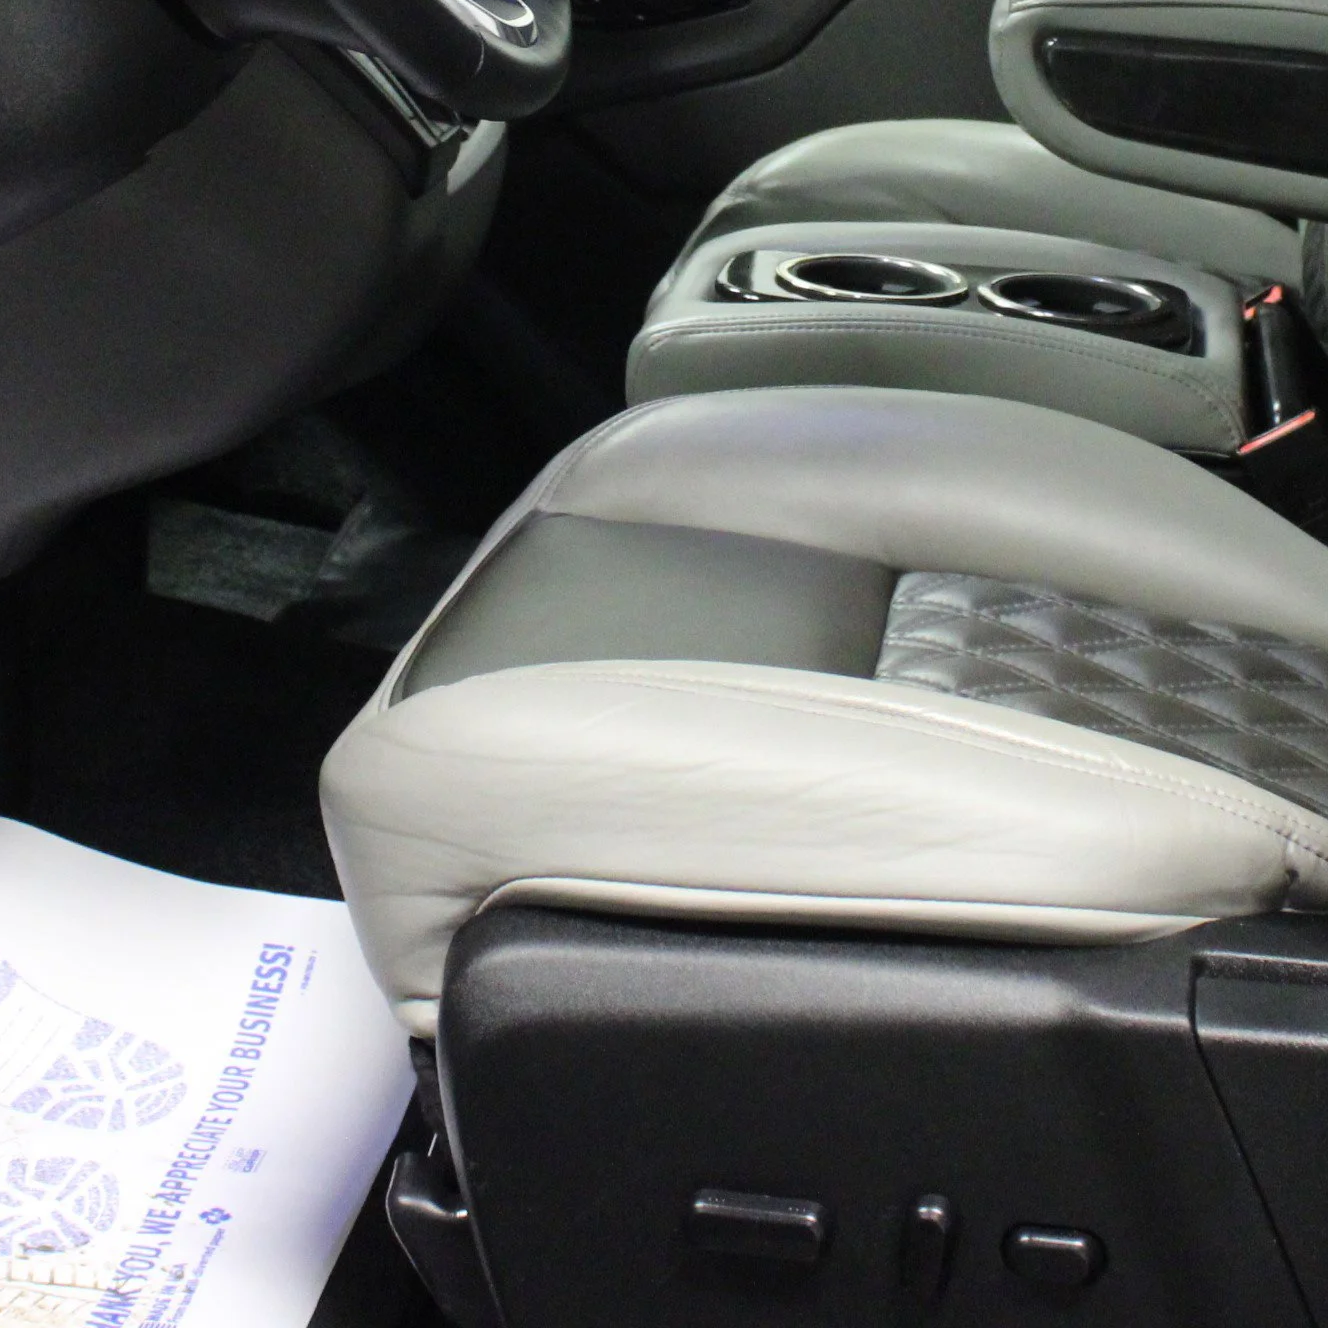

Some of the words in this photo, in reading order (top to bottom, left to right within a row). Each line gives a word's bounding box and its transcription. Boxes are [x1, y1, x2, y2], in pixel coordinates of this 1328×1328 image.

[229, 942, 295, 1061] BUSINESS!
[205, 1065, 256, 1112] YOUR
[156, 1115, 233, 1205] APPRECIATE
[136, 1208, 182, 1235] WE
[112, 1243, 172, 1281] YOU,
[146, 1297, 172, 1322] MADE
